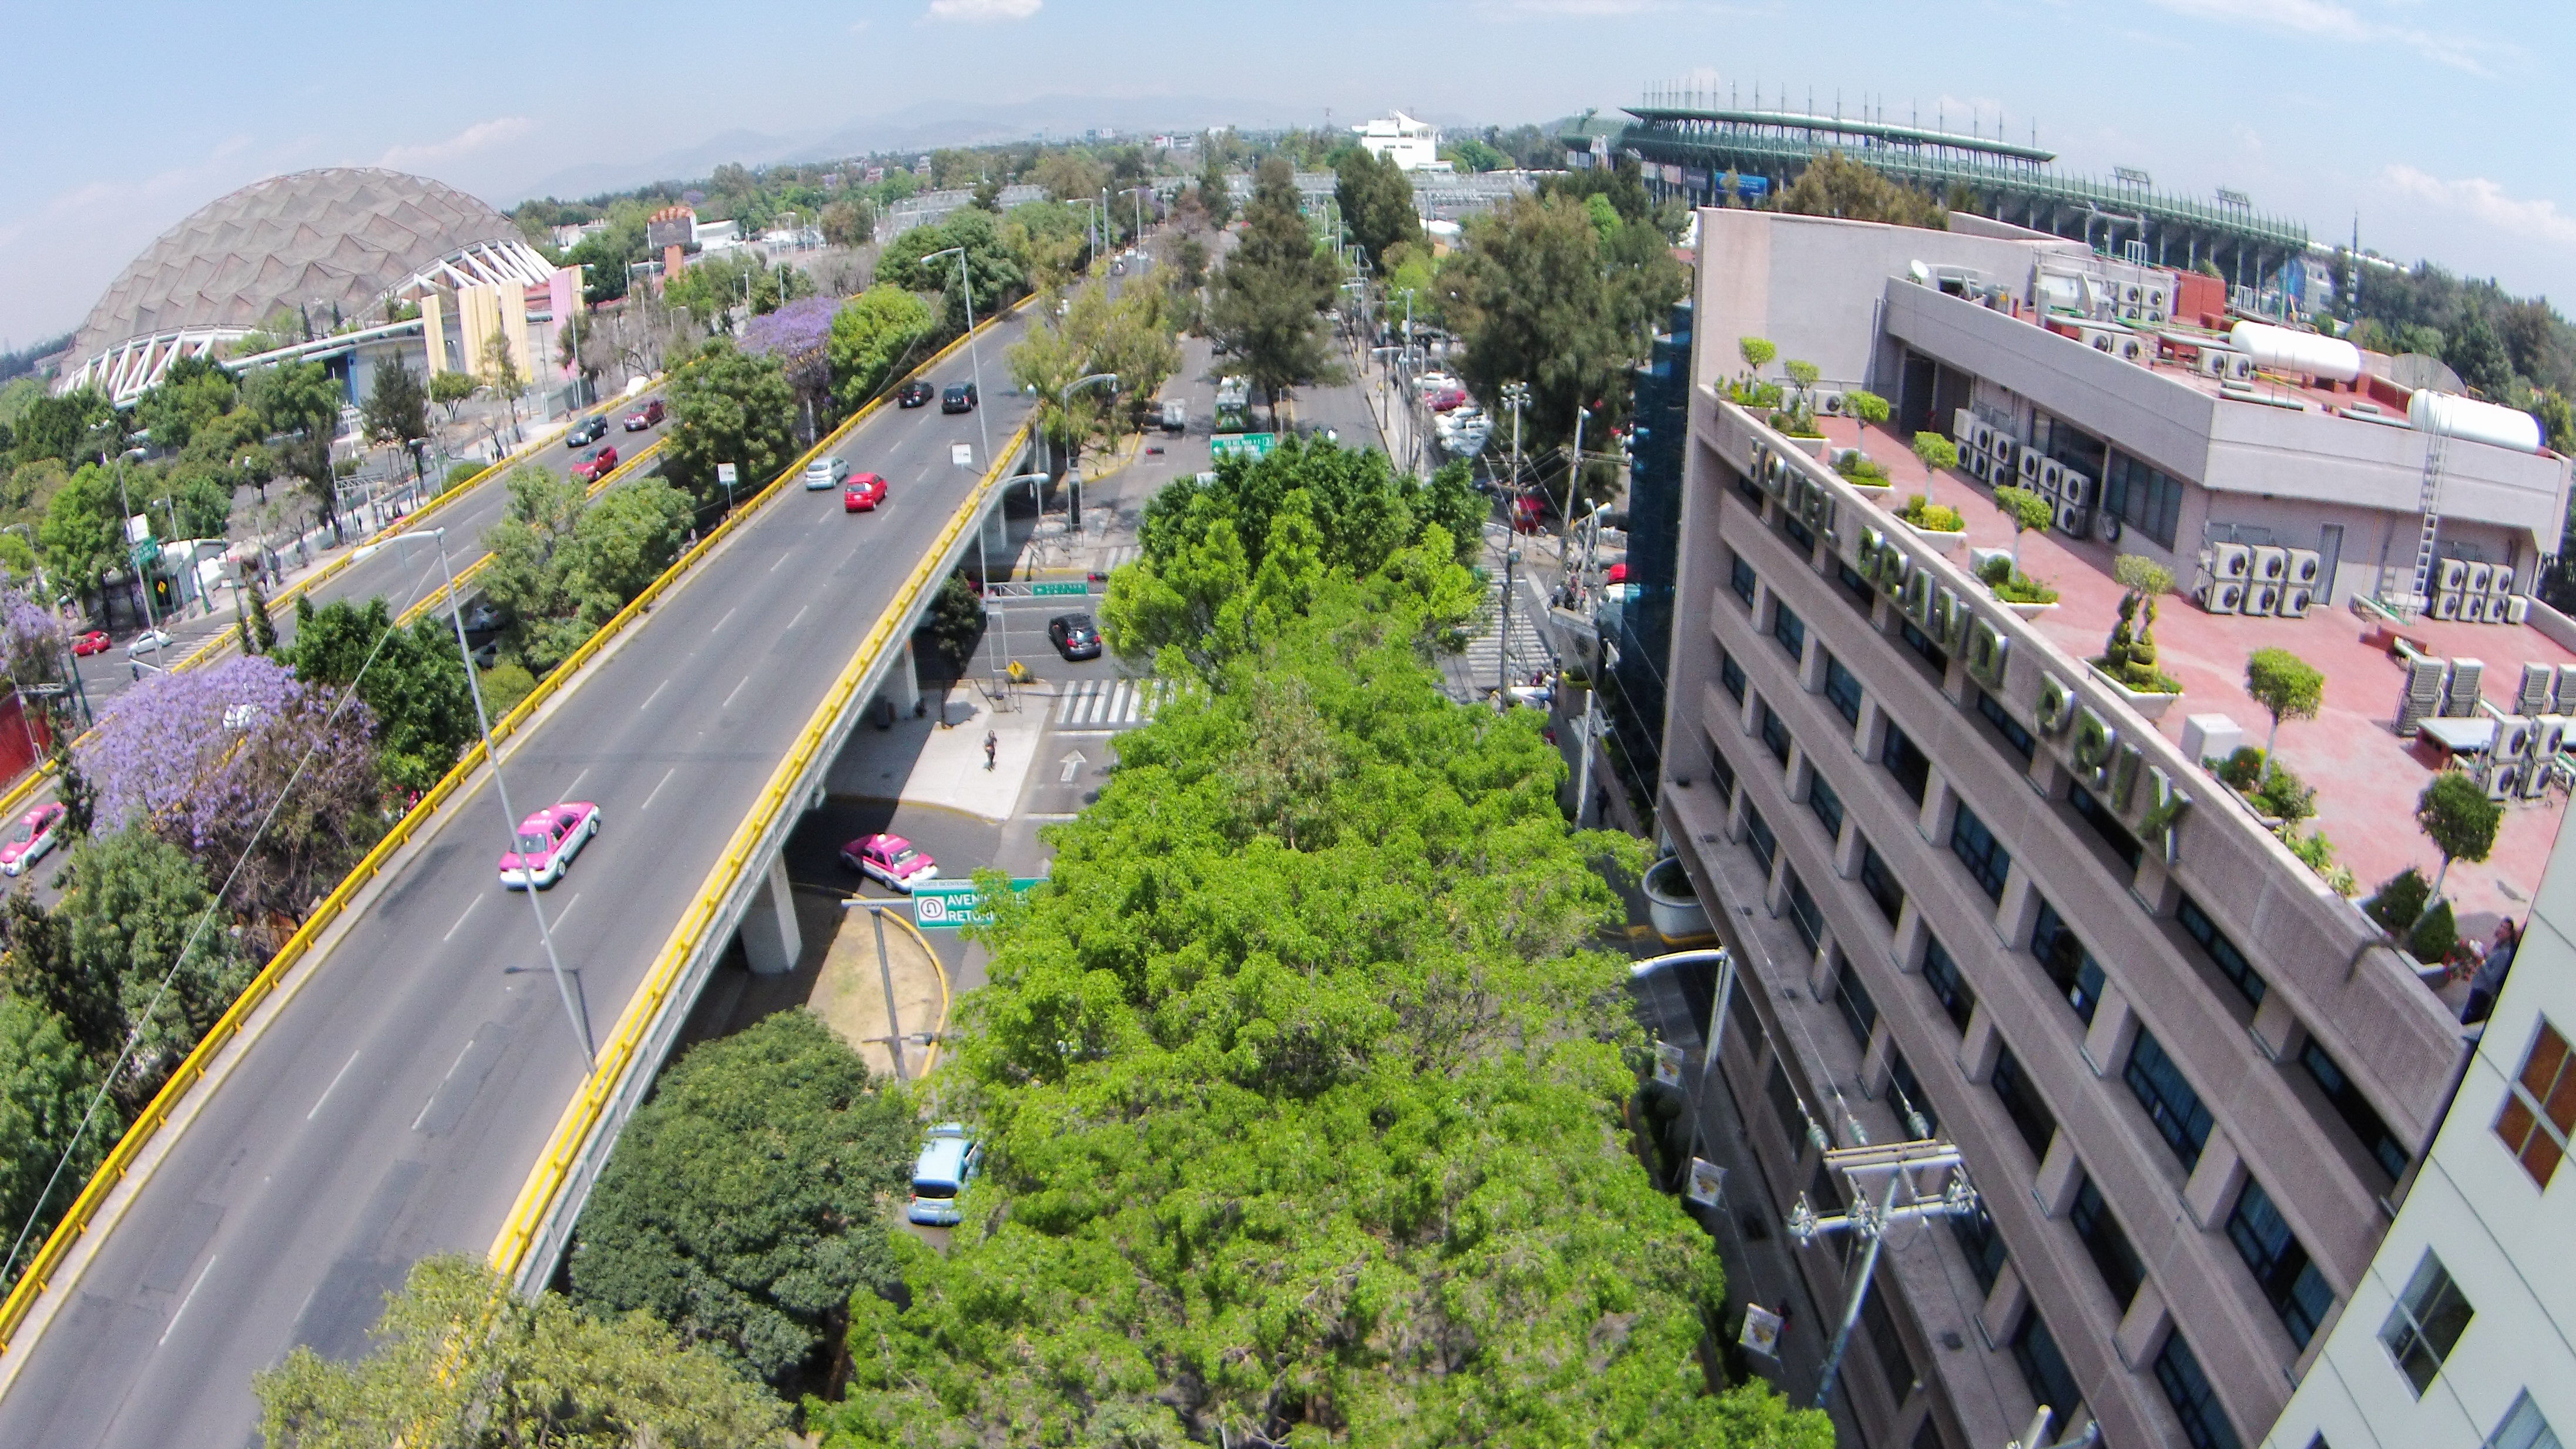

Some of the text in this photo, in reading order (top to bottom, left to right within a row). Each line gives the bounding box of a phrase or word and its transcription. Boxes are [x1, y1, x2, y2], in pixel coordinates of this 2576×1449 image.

[1749, 435, 2193, 866] HOTEL GRAND PRIX
[947, 894, 991, 906] AVENI
